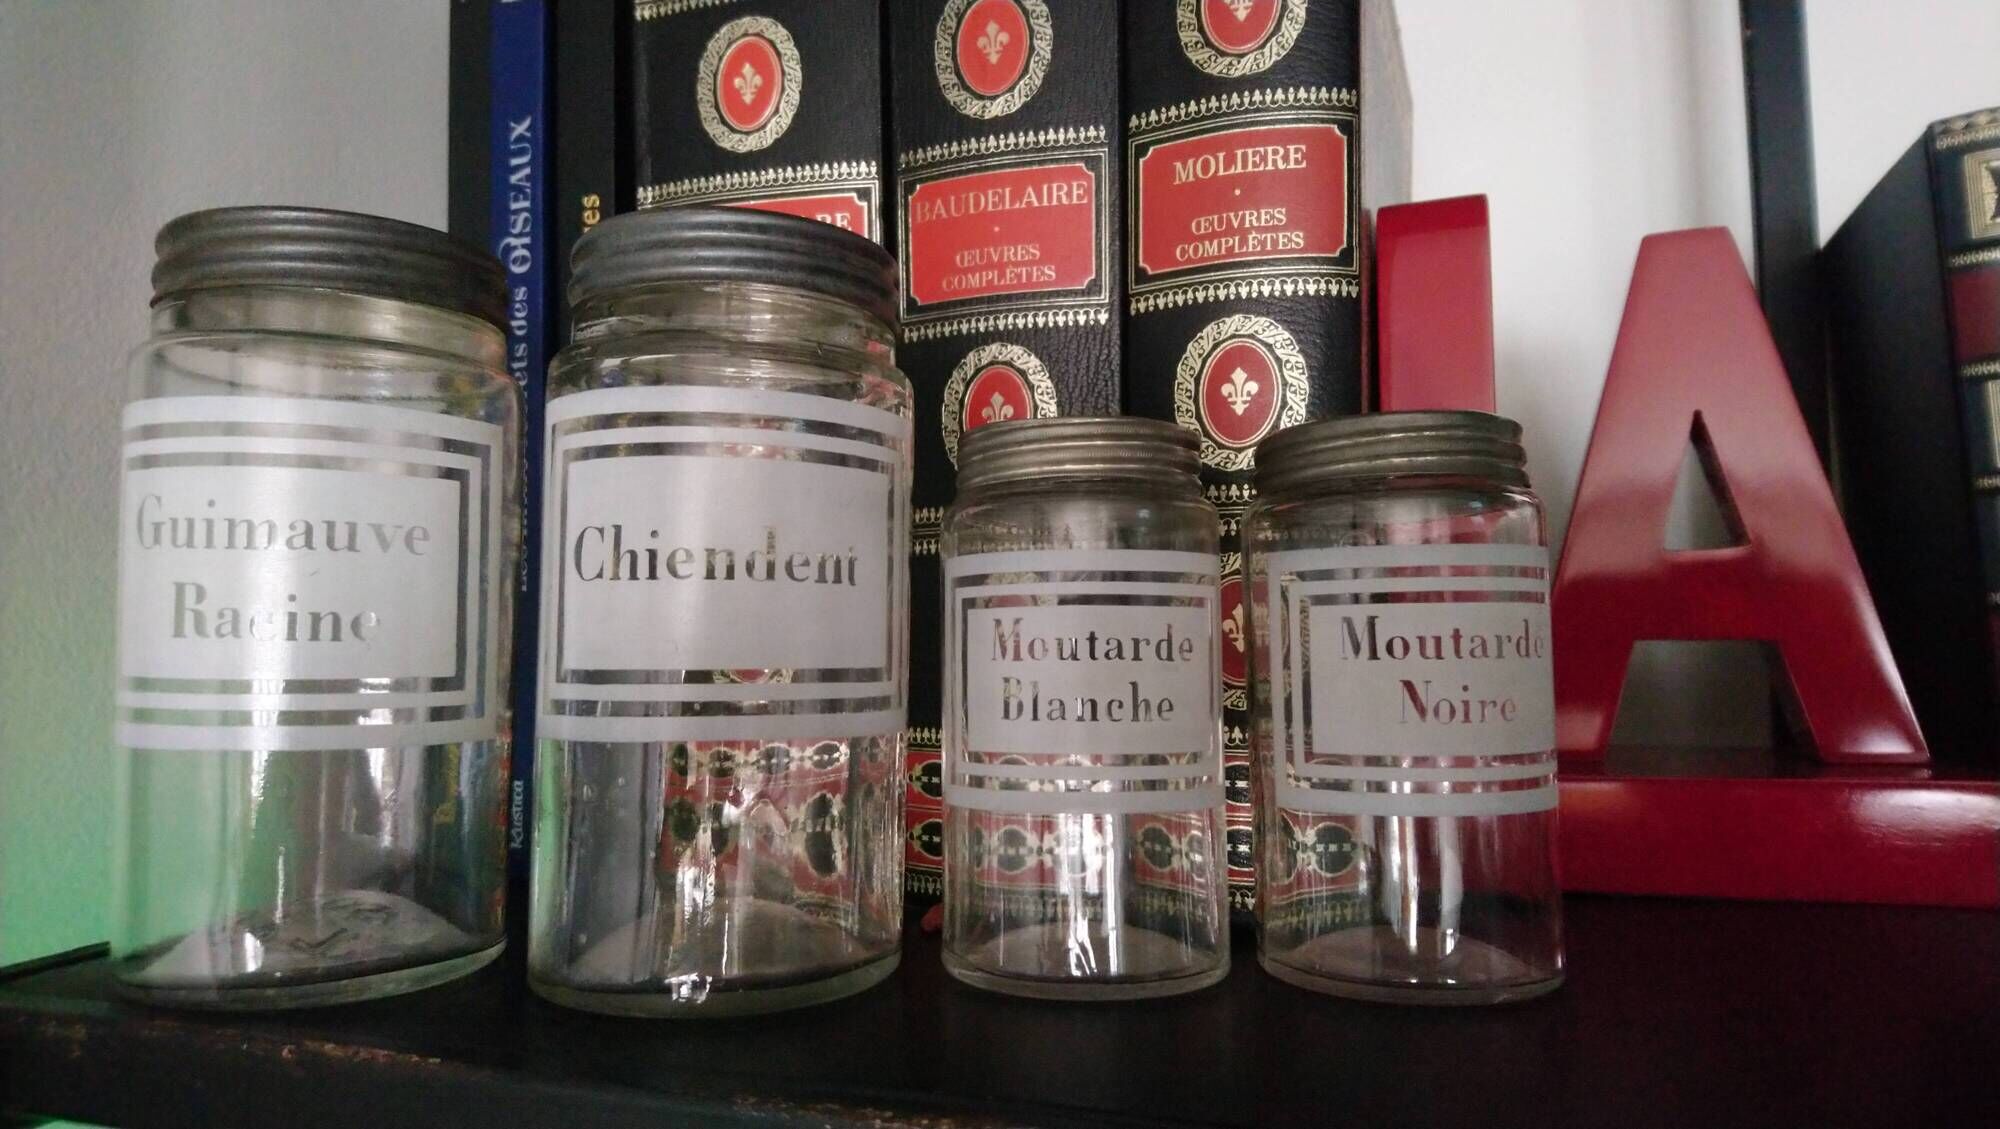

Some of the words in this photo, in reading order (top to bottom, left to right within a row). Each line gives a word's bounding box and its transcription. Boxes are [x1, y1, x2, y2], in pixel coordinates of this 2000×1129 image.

[1172, 144, 1307, 185] MOLIERE
[499, 115, 533, 274] OISEAUX
[914, 180, 1089, 224] BAUDELAIRE
[1191, 207, 1287, 235] ŒUVRES
[955, 243, 1041, 268] ŒUVRES
[1175, 230, 1305, 262] COMPLÈTES
[941, 264, 1057, 292] COMPLÈTES
[136, 493, 431, 556] Guimauve
[573, 523, 859, 587] Chiendent
[171, 580, 381, 642] Racine
[990, 616, 1194, 663] Moutarde
[1340, 614, 1544, 662] Moutarde
[1000, 676, 1175, 723] Blanche
[1398, 679, 1517, 726] Noire
